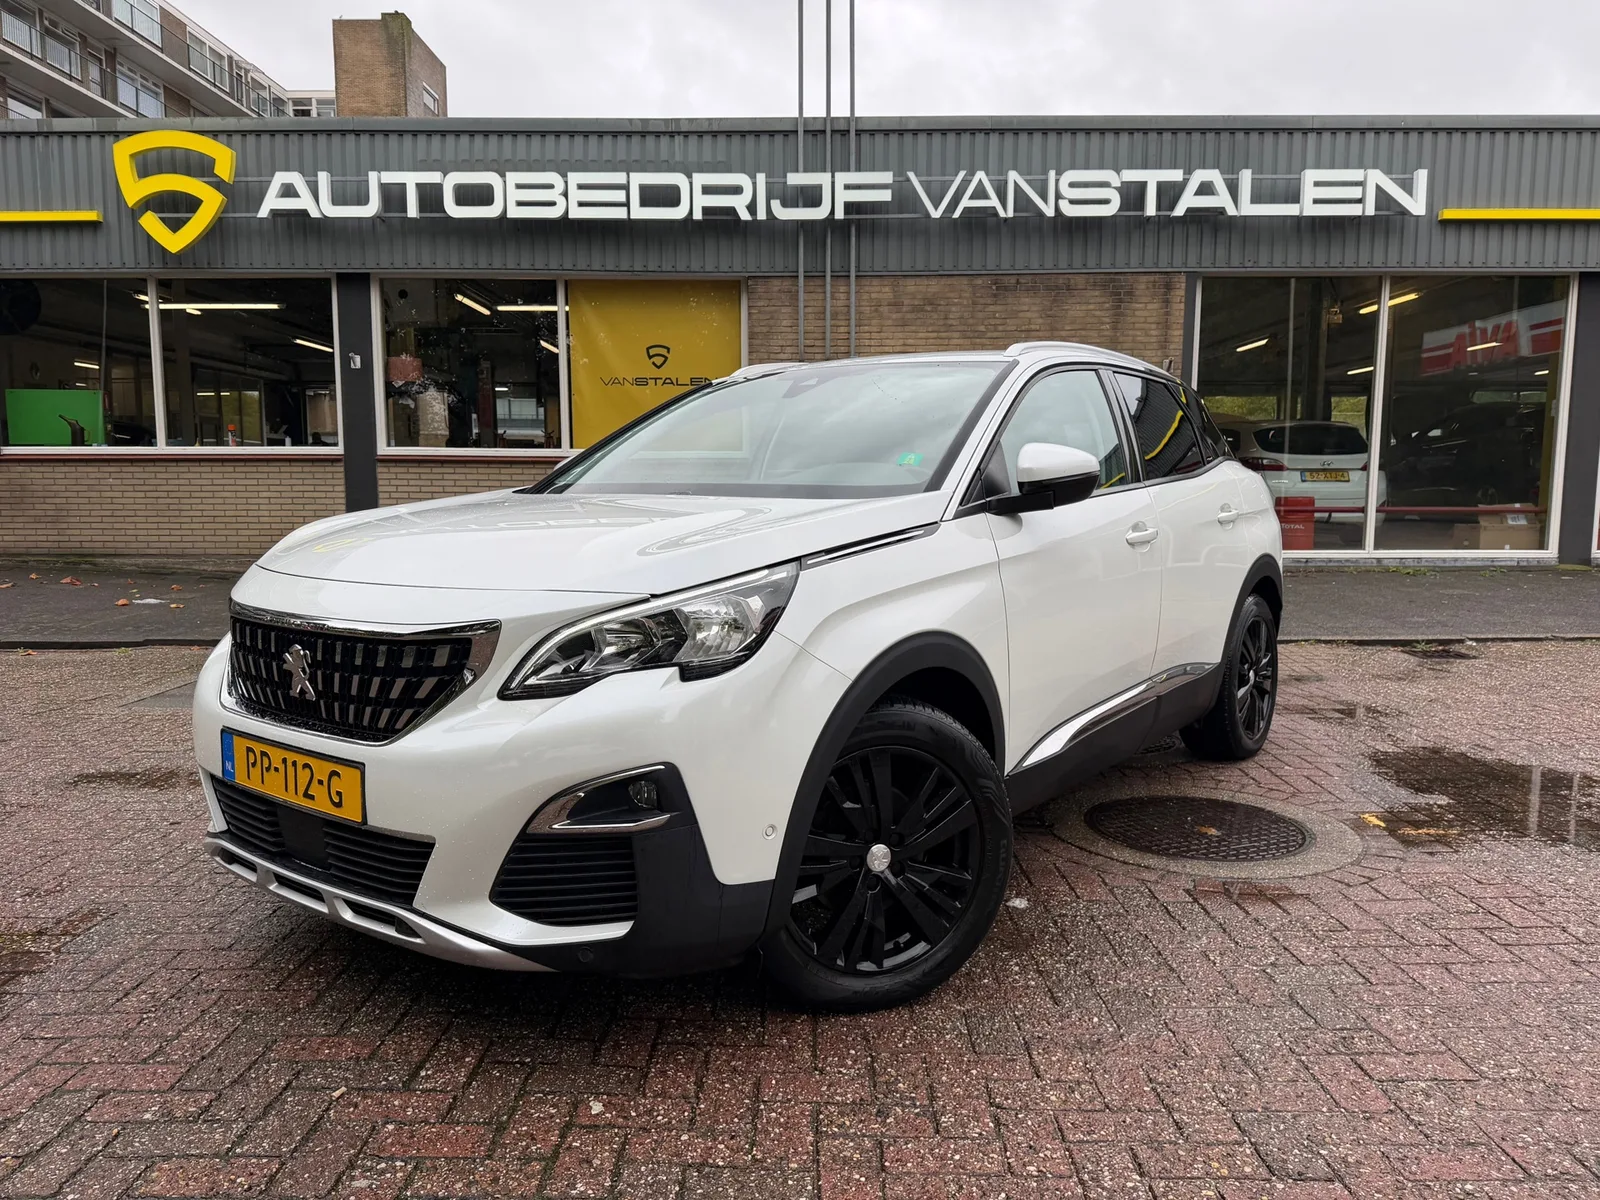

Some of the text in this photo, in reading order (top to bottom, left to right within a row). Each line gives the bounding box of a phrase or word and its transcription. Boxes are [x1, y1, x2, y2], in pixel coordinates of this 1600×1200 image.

[256, 169, 1428, 220] AUTOBEDRIJF VANSTALEN
[1280, 522, 1305, 530] TOTAL
[225, 760, 234, 773] NL
[245, 746, 343, 809] PP-112-G
